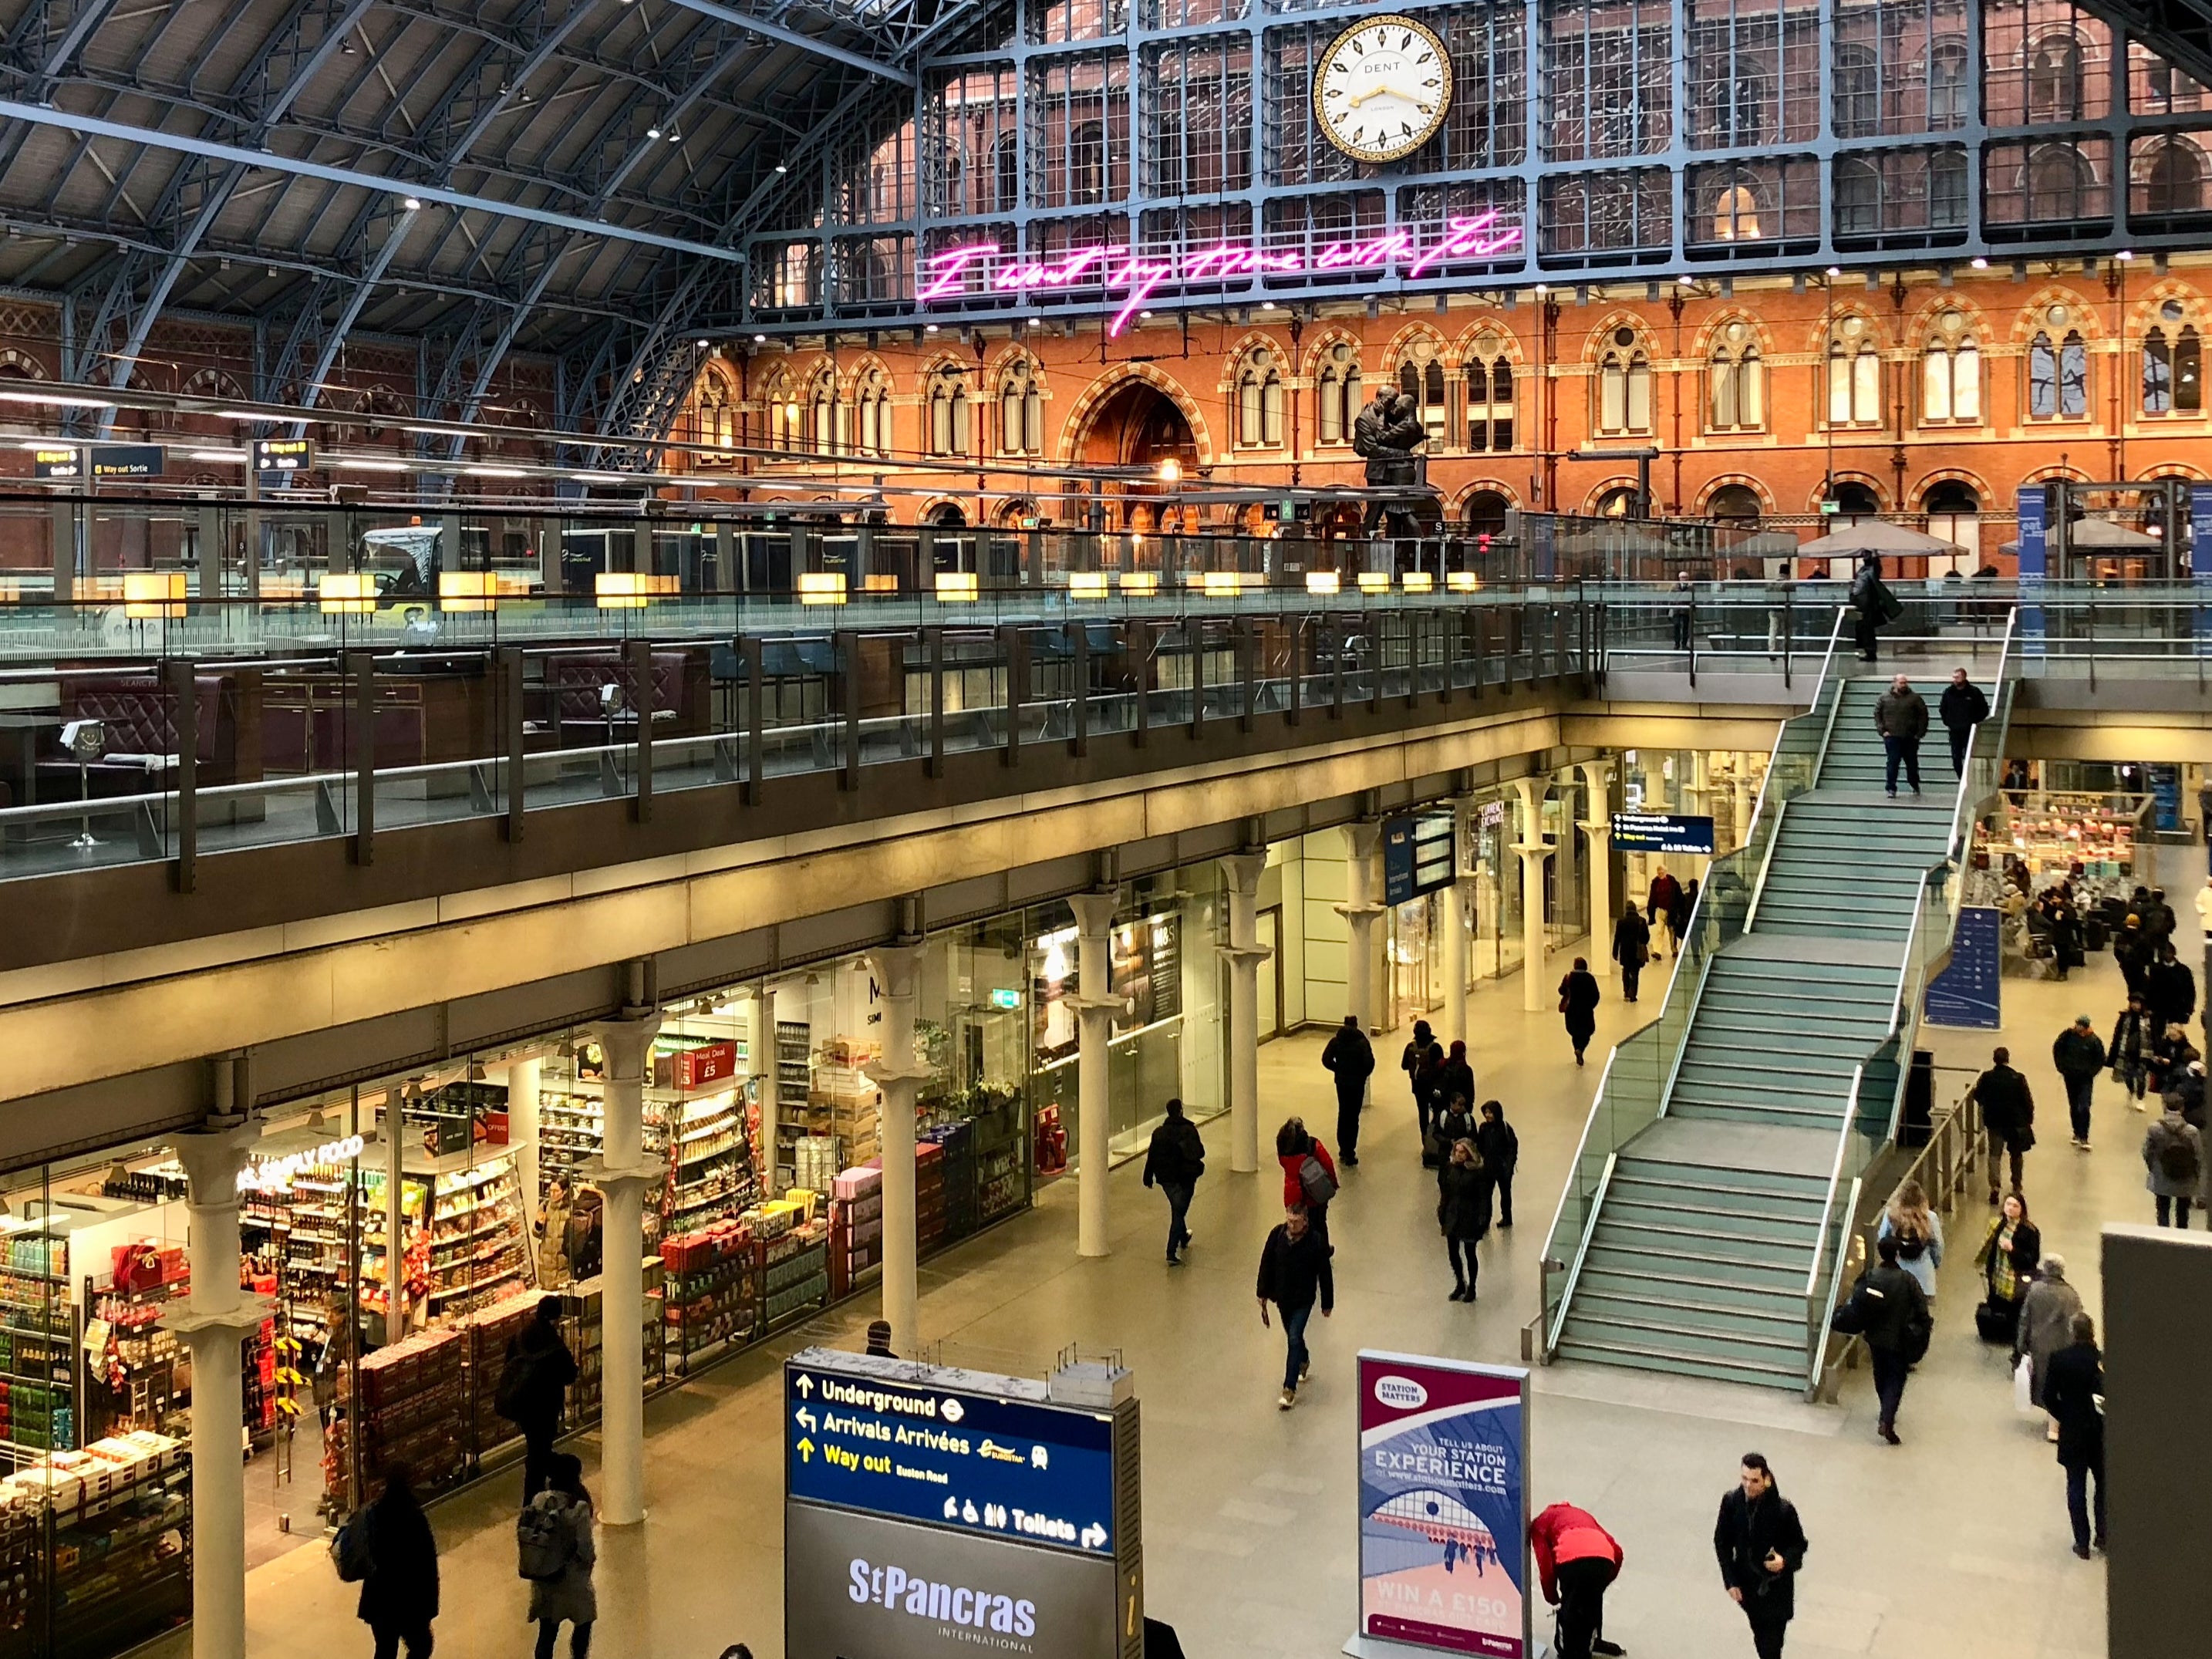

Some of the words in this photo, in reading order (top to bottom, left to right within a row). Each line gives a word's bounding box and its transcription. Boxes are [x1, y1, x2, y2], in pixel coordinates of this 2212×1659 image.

[1364, 62, 1401, 73] DENT
[915, 244, 1000, 301] I
[103, 465, 116, 474] Way
[1435, 521, 1442, 531] S
[696, 1050, 710, 1060] Meal
[711, 1047, 726, 1058] Deal
[703, 1064, 716, 1078] £5
[487, 1124, 507, 1132] OFFERS
[318, 1135, 365, 1166] FOOD
[821, 1379, 936, 1417] Underground
[1381, 1382, 1418, 1394] STATION
[1381, 1391, 1421, 1403] MATTERS
[823, 1412, 892, 1442] Arrivals
[895, 1424, 970, 1455] Arrivées
[1411, 1442, 1447, 1458] YOUR
[1451, 1448, 1506, 1466] STATION
[1438, 1437, 1459, 1448] TELL
[1461, 1440, 1473, 1450] US
[1475, 1442, 1505, 1455] ABOUT
[823, 1443, 860, 1472] Way
[863, 1455, 892, 1474] out
[895, 1465, 926, 1480] Euston
[926, 1469, 949, 1485] Road
[1374, 1450, 1506, 1485] EXPERIENCE
[1388, 1472, 1507, 1495] www.stationmatters.com
[1011, 1509, 1076, 1541] Toilets
[885, 1564, 1037, 1638] Pancras
[1376, 1580, 1420, 1603] WIN
[1428, 1589, 1443, 1608] A
[1452, 1593, 1508, 1618] £150
[938, 1627, 1035, 1654] INTERNATIONAL
